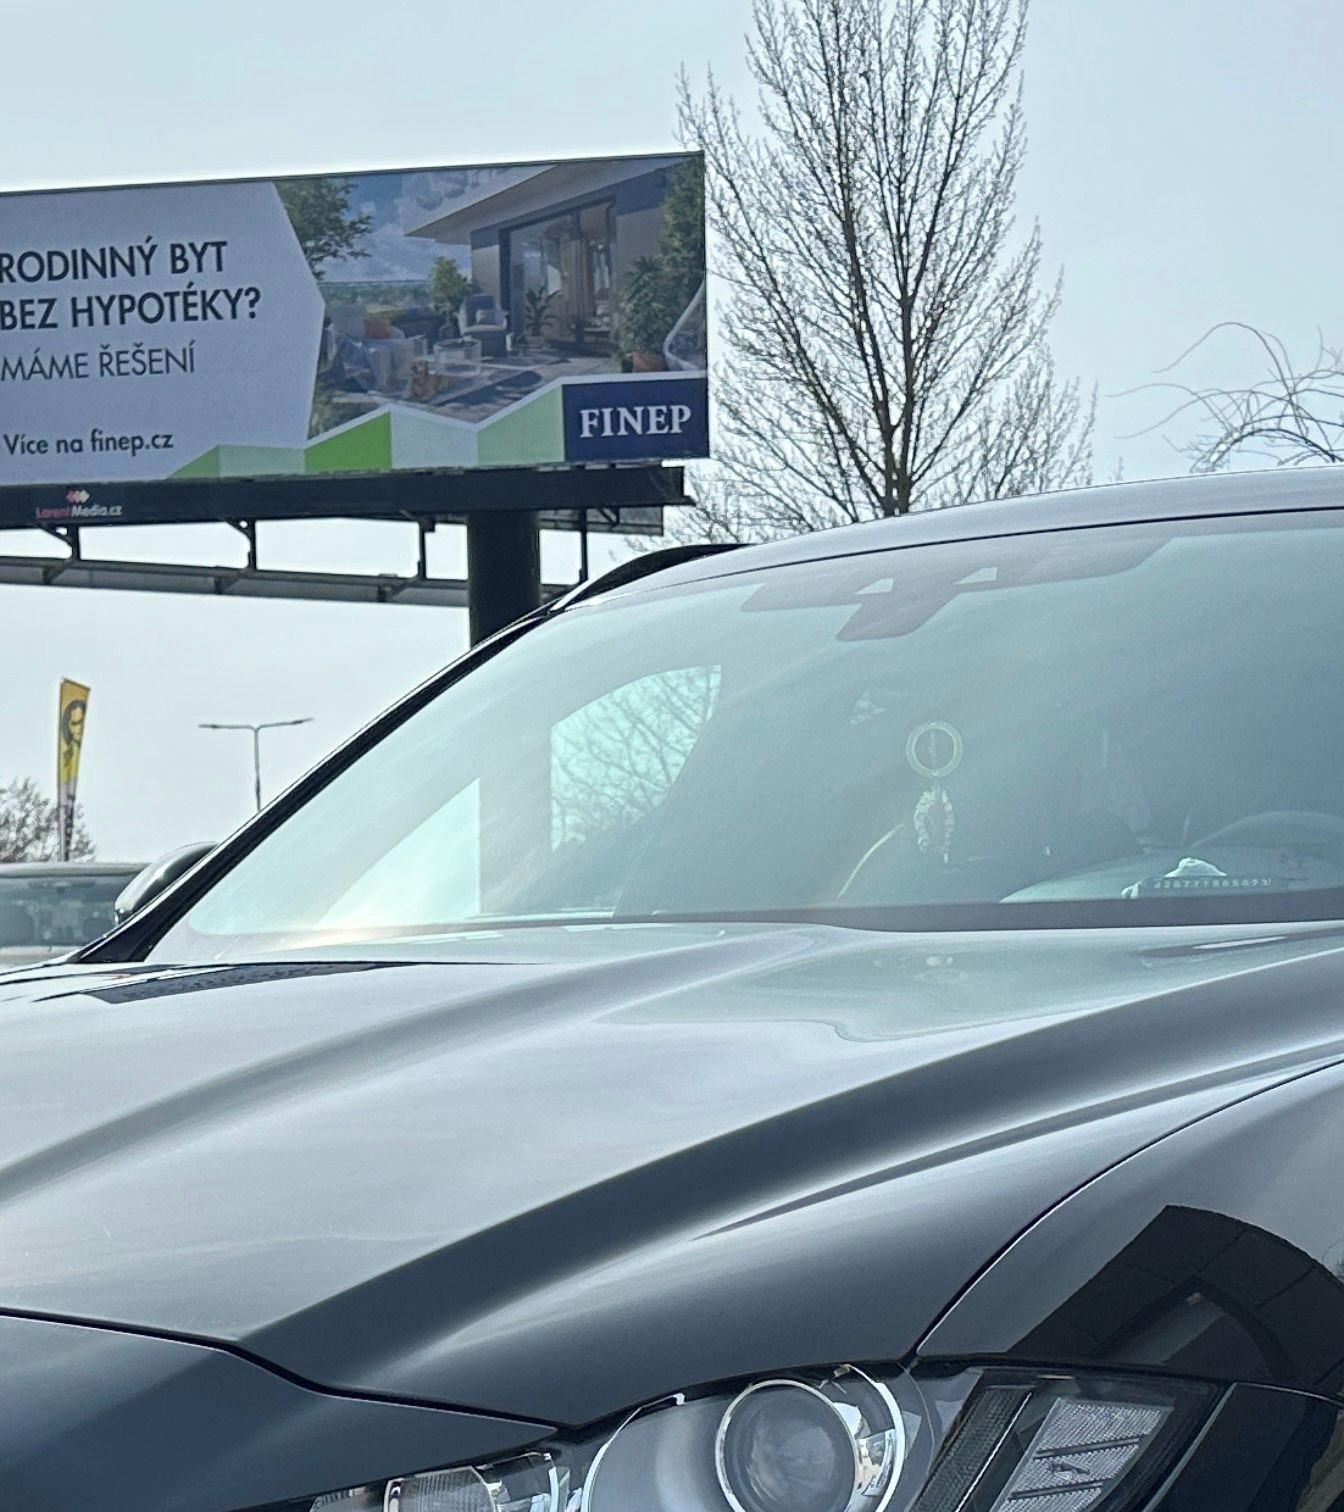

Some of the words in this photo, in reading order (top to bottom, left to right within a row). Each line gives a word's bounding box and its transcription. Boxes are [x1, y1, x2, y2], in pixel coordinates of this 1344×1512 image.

[169, 241, 228, 275] BYT
[0, 298, 58, 330] BEZ
[70, 281, 261, 328] HYPOTÉKY?
[0, 347, 89, 382] MÁME
[99, 340, 196, 377] ŘEŠENÍ
[579, 404, 692, 438] FINEP
[3, 433, 49, 455] Více
[56, 437, 83, 454] na
[90, 428, 174, 457] finep.cz
